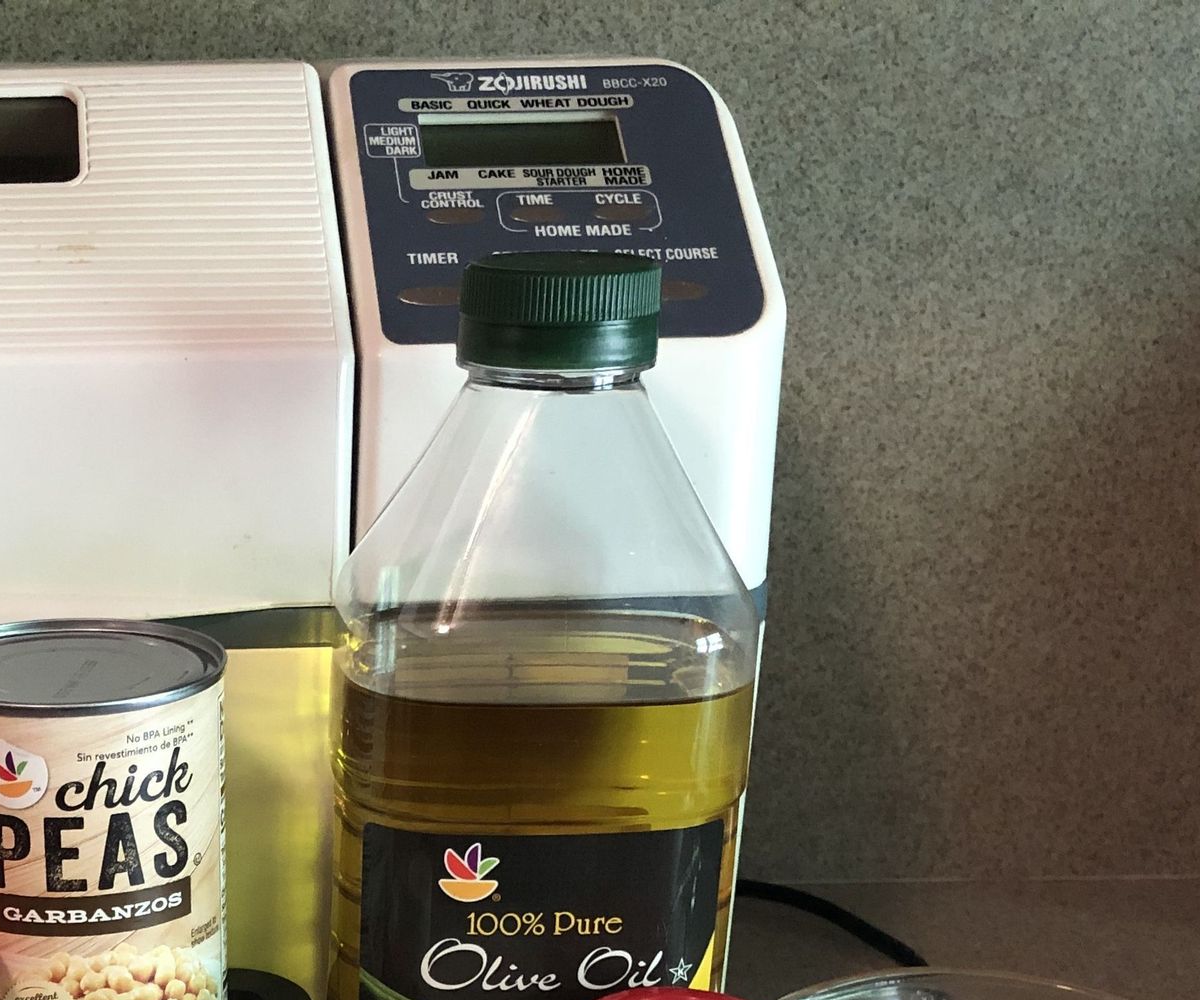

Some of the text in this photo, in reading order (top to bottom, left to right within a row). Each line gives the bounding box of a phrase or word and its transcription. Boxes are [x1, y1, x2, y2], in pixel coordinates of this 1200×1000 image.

[478, 73, 667, 94] ZOJIRUSHI BBCC-X20
[411, 97, 629, 110] BASIC QUICK WHEAT DOUGH
[380, 126, 413, 137] LIGHT
[369, 136, 416, 147] MEDIUM
[386, 145, 418, 156] DARK
[428, 167, 645, 180] JAM CAKE SOUR DOUGH HOME
[536, 175, 647, 186] STARTER MADE
[429, 191, 473, 200] CRUST
[516, 193, 643, 206] TIME CYCLE
[421, 199, 484, 209] CONTROL
[535, 223, 632, 237] HOME MADE
[407, 252, 459, 265] TIMER
[665, 247, 719, 260] COURSE
[126, 734, 141, 744] No
[143, 730, 161, 741] BPA
[77, 741, 171, 762] Sin revestimiento de
[55, 746, 193, 812] chick
[3, 892, 183, 924] GARBANZOS
[466, 911, 624, 937] 100% Pure
[420, 937, 664, 992] Olive Oil
